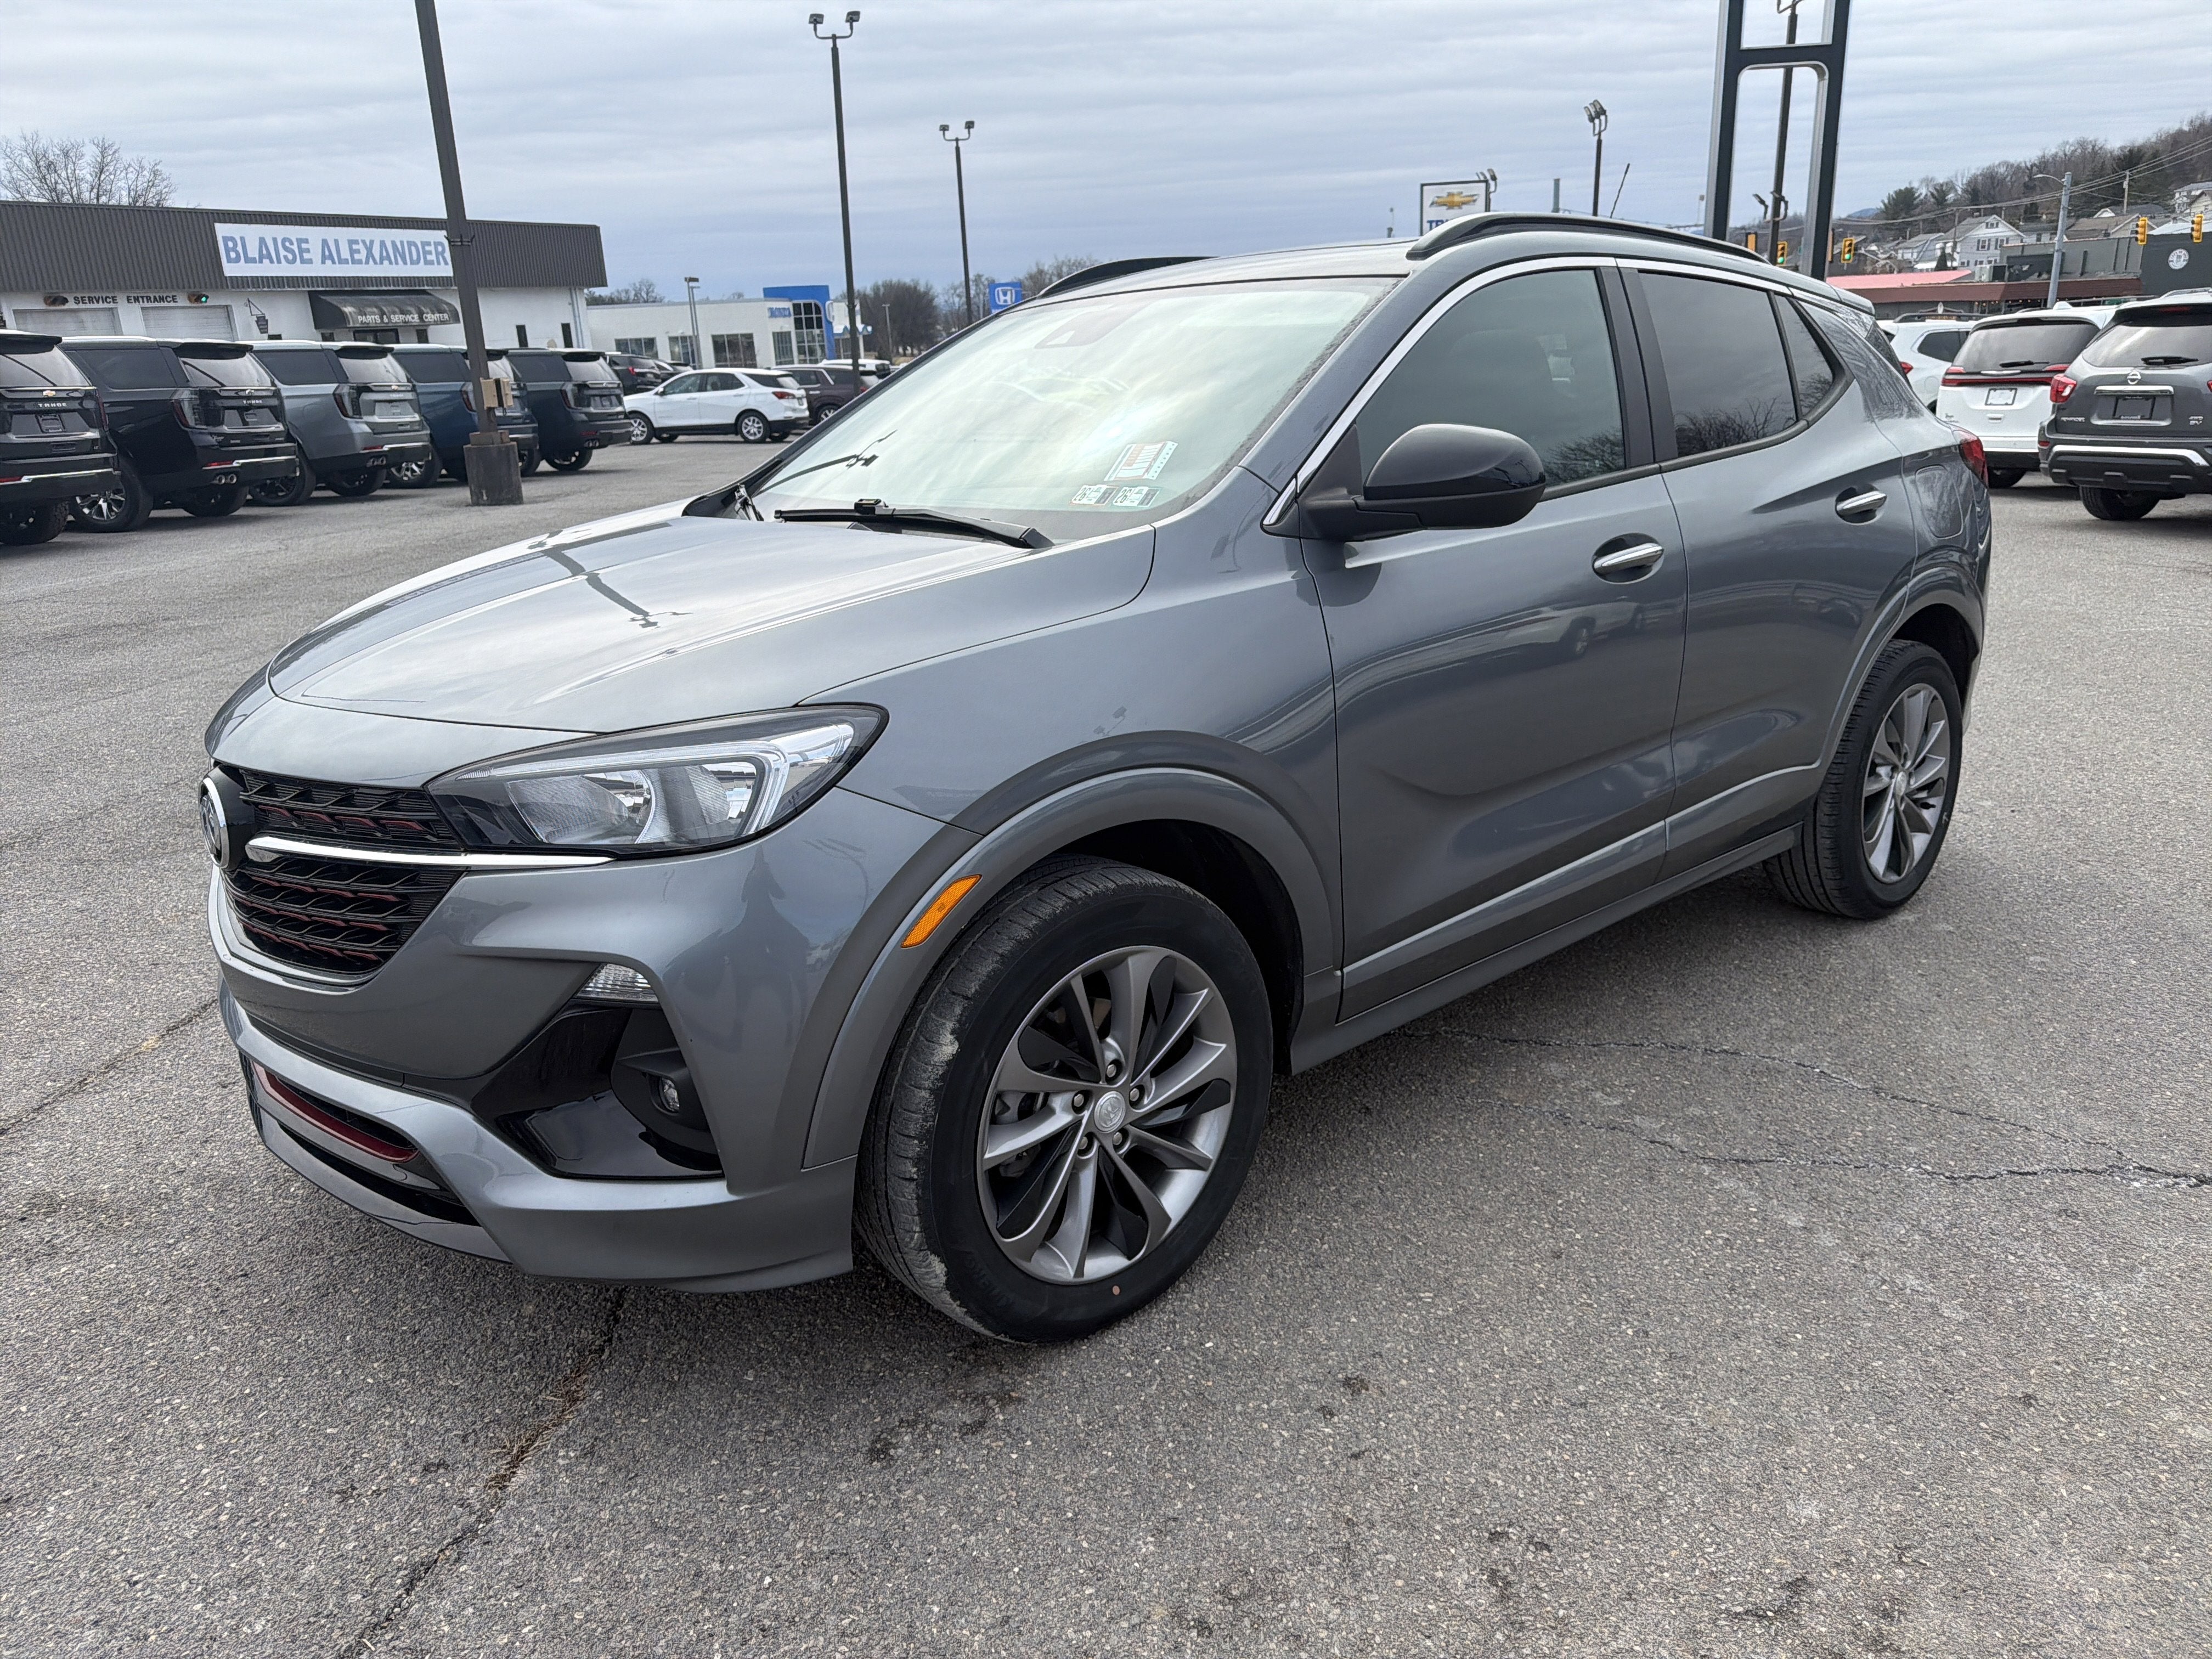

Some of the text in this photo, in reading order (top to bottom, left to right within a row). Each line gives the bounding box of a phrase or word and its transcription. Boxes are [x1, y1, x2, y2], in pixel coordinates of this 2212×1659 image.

[222, 235, 449, 266] BLAISE ALEXANDER
[73, 295, 178, 304] SERVICE ENTRANCE
[358, 315, 381, 323] PARTS
[391, 314, 420, 323] SERVICE
[423, 313, 449, 321] CENTER
